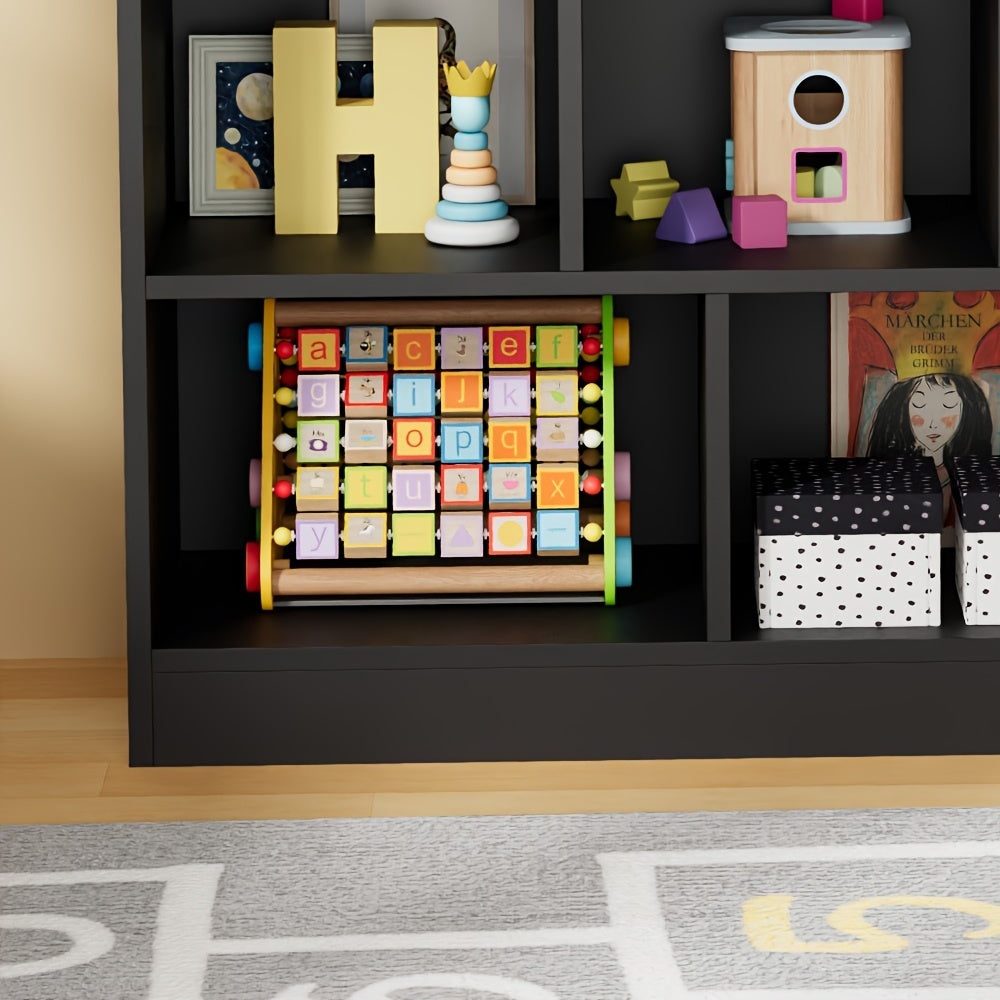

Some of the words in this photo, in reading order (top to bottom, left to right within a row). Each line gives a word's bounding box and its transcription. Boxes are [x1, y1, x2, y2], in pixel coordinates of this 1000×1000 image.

[272, 20, 439, 234] H
[500, 337, 518, 356] e
[552, 334, 562, 359] f
[922, 331, 945, 341] DER
[310, 341, 327, 360] a
[406, 341, 421, 360] c
[912, 358, 954, 368] GRIMM
[311, 382, 327, 408] g
[412, 382, 416, 406] i
[504, 382, 517, 406] k
[456, 431, 471, 456] p
[501, 430, 518, 456] q
[360, 475, 371, 497] t
[406, 480, 421, 499] u
[550, 479, 565, 498] x
[310, 527, 327, 552] y
